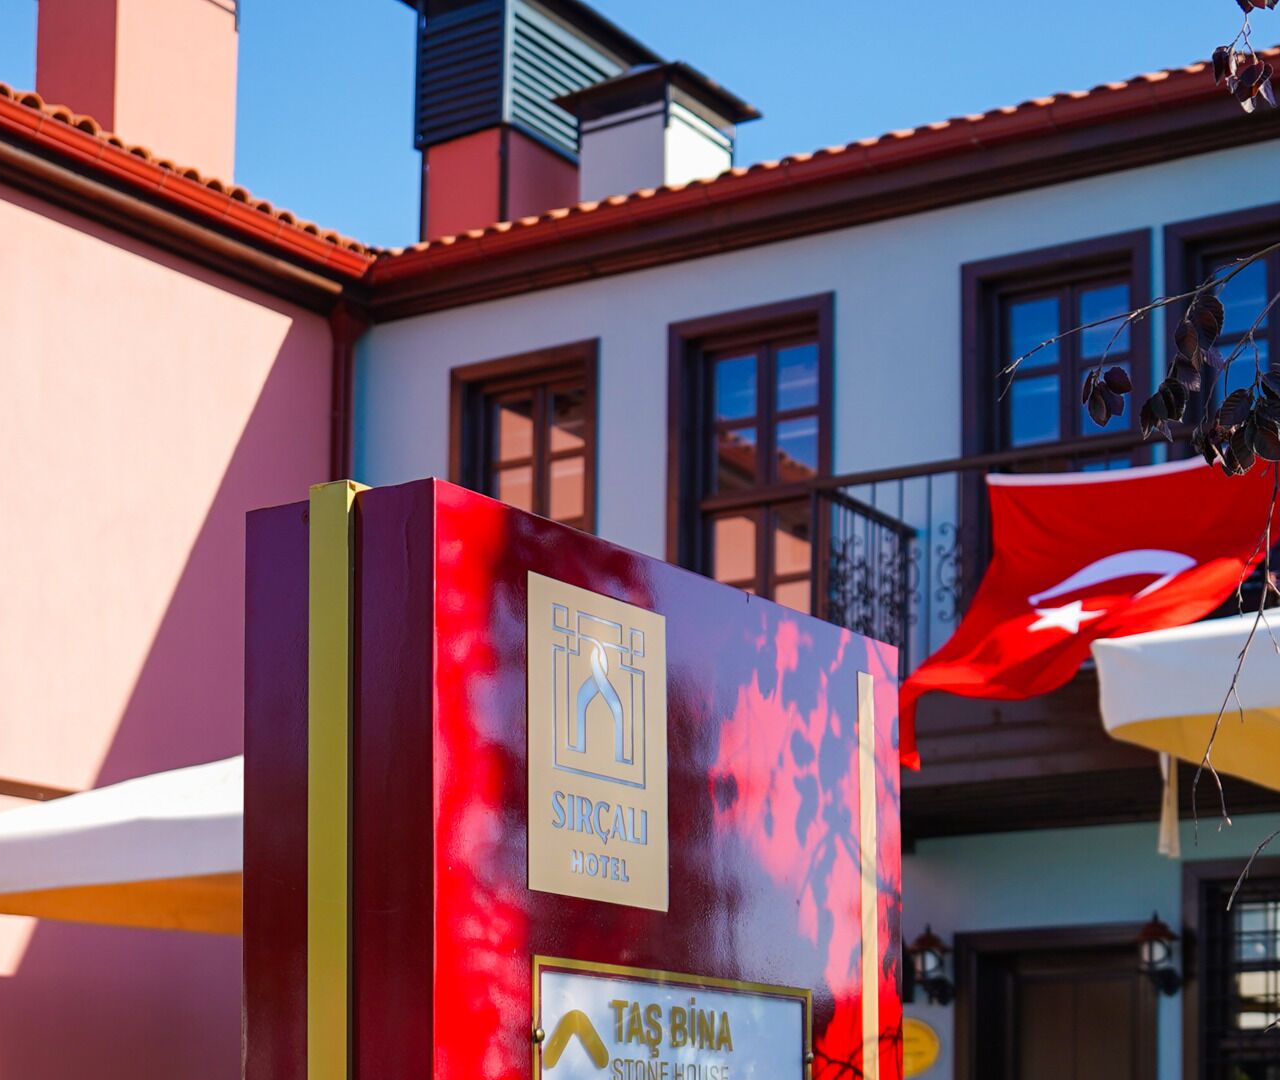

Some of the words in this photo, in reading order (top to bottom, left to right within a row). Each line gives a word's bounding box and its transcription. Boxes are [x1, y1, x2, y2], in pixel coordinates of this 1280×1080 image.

[551, 790, 648, 845] SIRÇALI
[571, 848, 629, 882] HOTEL
[611, 999, 663, 1058] TAŞ
[671, 997, 734, 1052] BİNA
